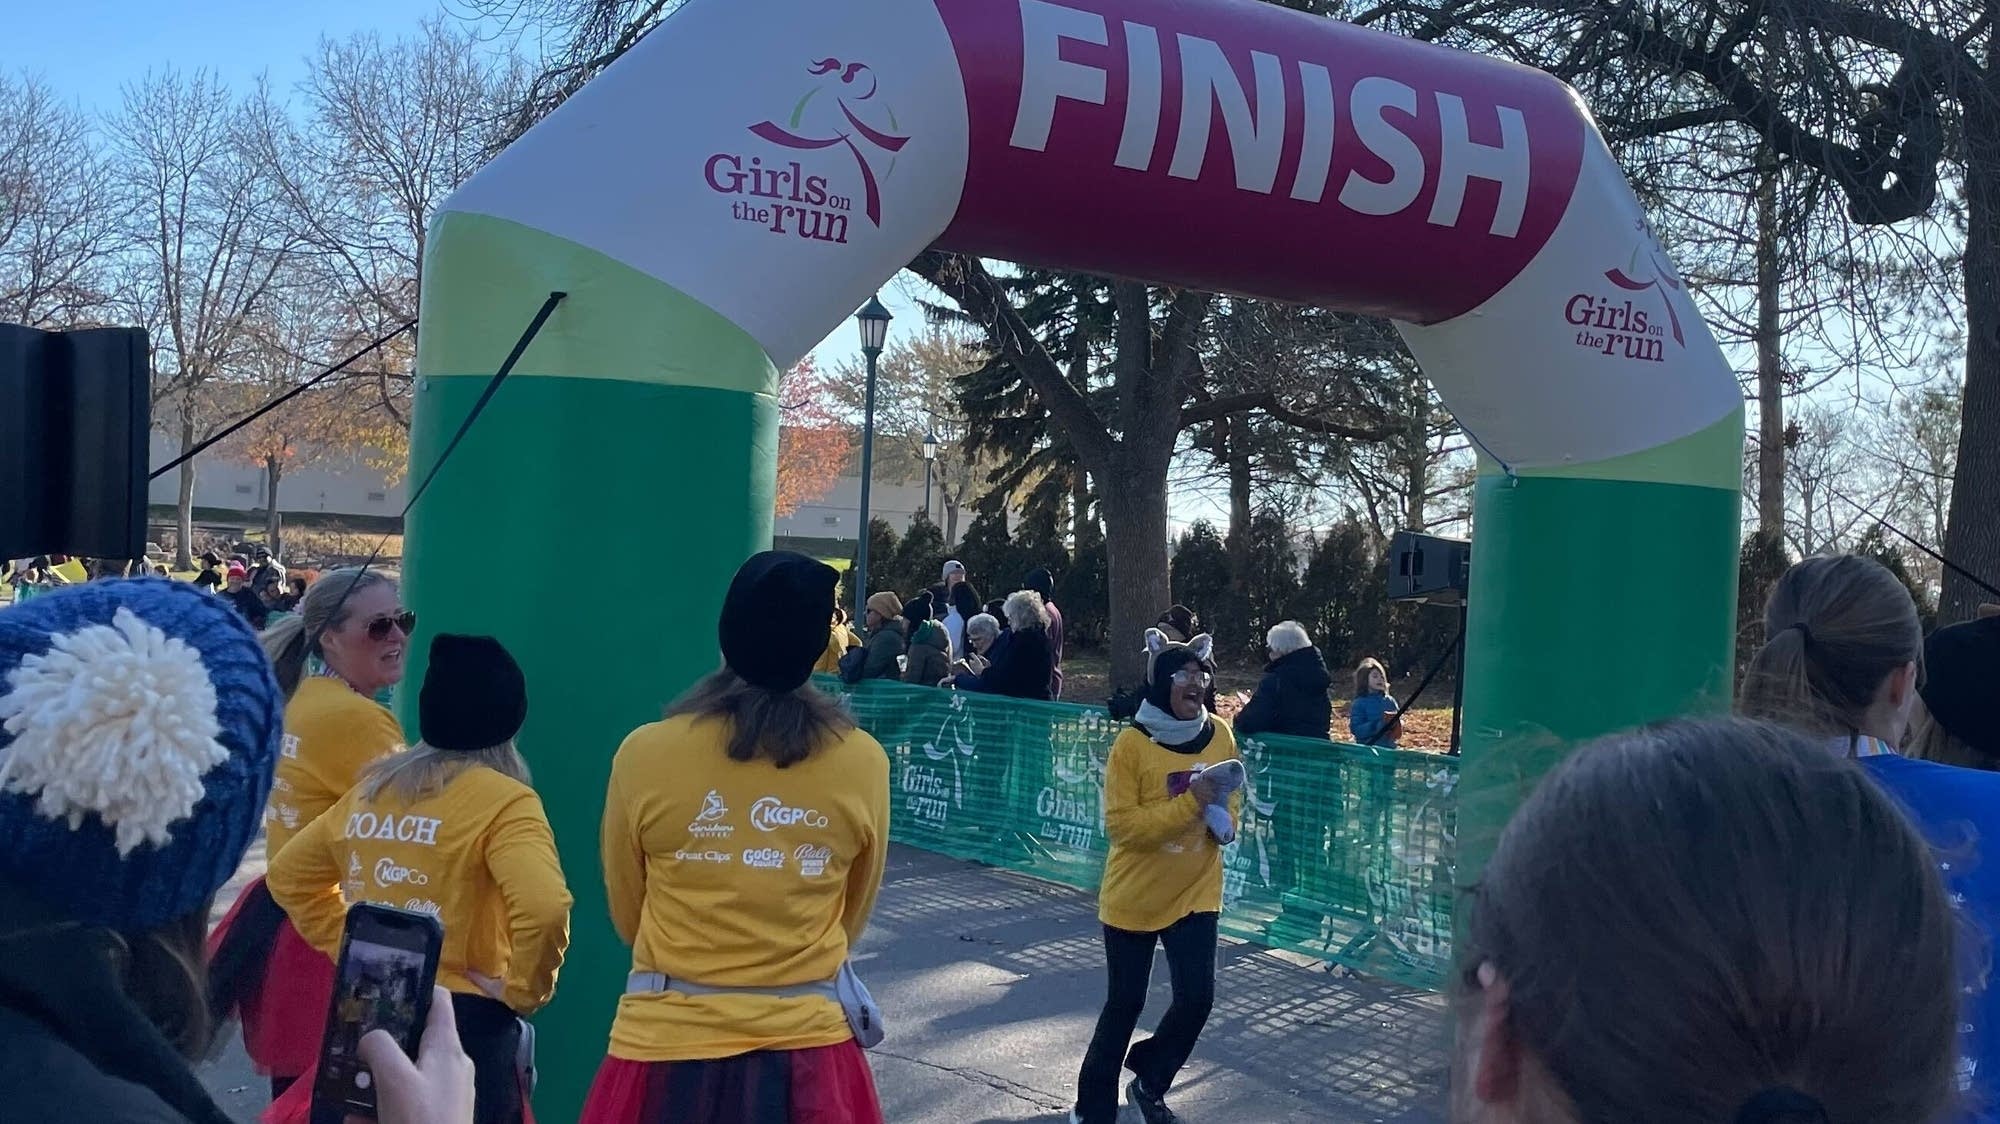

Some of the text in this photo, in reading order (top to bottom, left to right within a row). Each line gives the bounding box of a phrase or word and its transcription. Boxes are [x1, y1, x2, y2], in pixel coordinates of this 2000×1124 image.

[1009, 0, 1530, 239] FINISH
[704, 153, 851, 211] Girls on
[732, 200, 849, 244] the run
[1564, 294, 1664, 336] Girls on
[1576, 330, 1664, 362] the run
[903, 765, 943, 797] Girls
[345, 812, 442, 845] COACH
[764, 806, 828, 828] KGPCo
[382, 864, 429, 886] KGPCo
